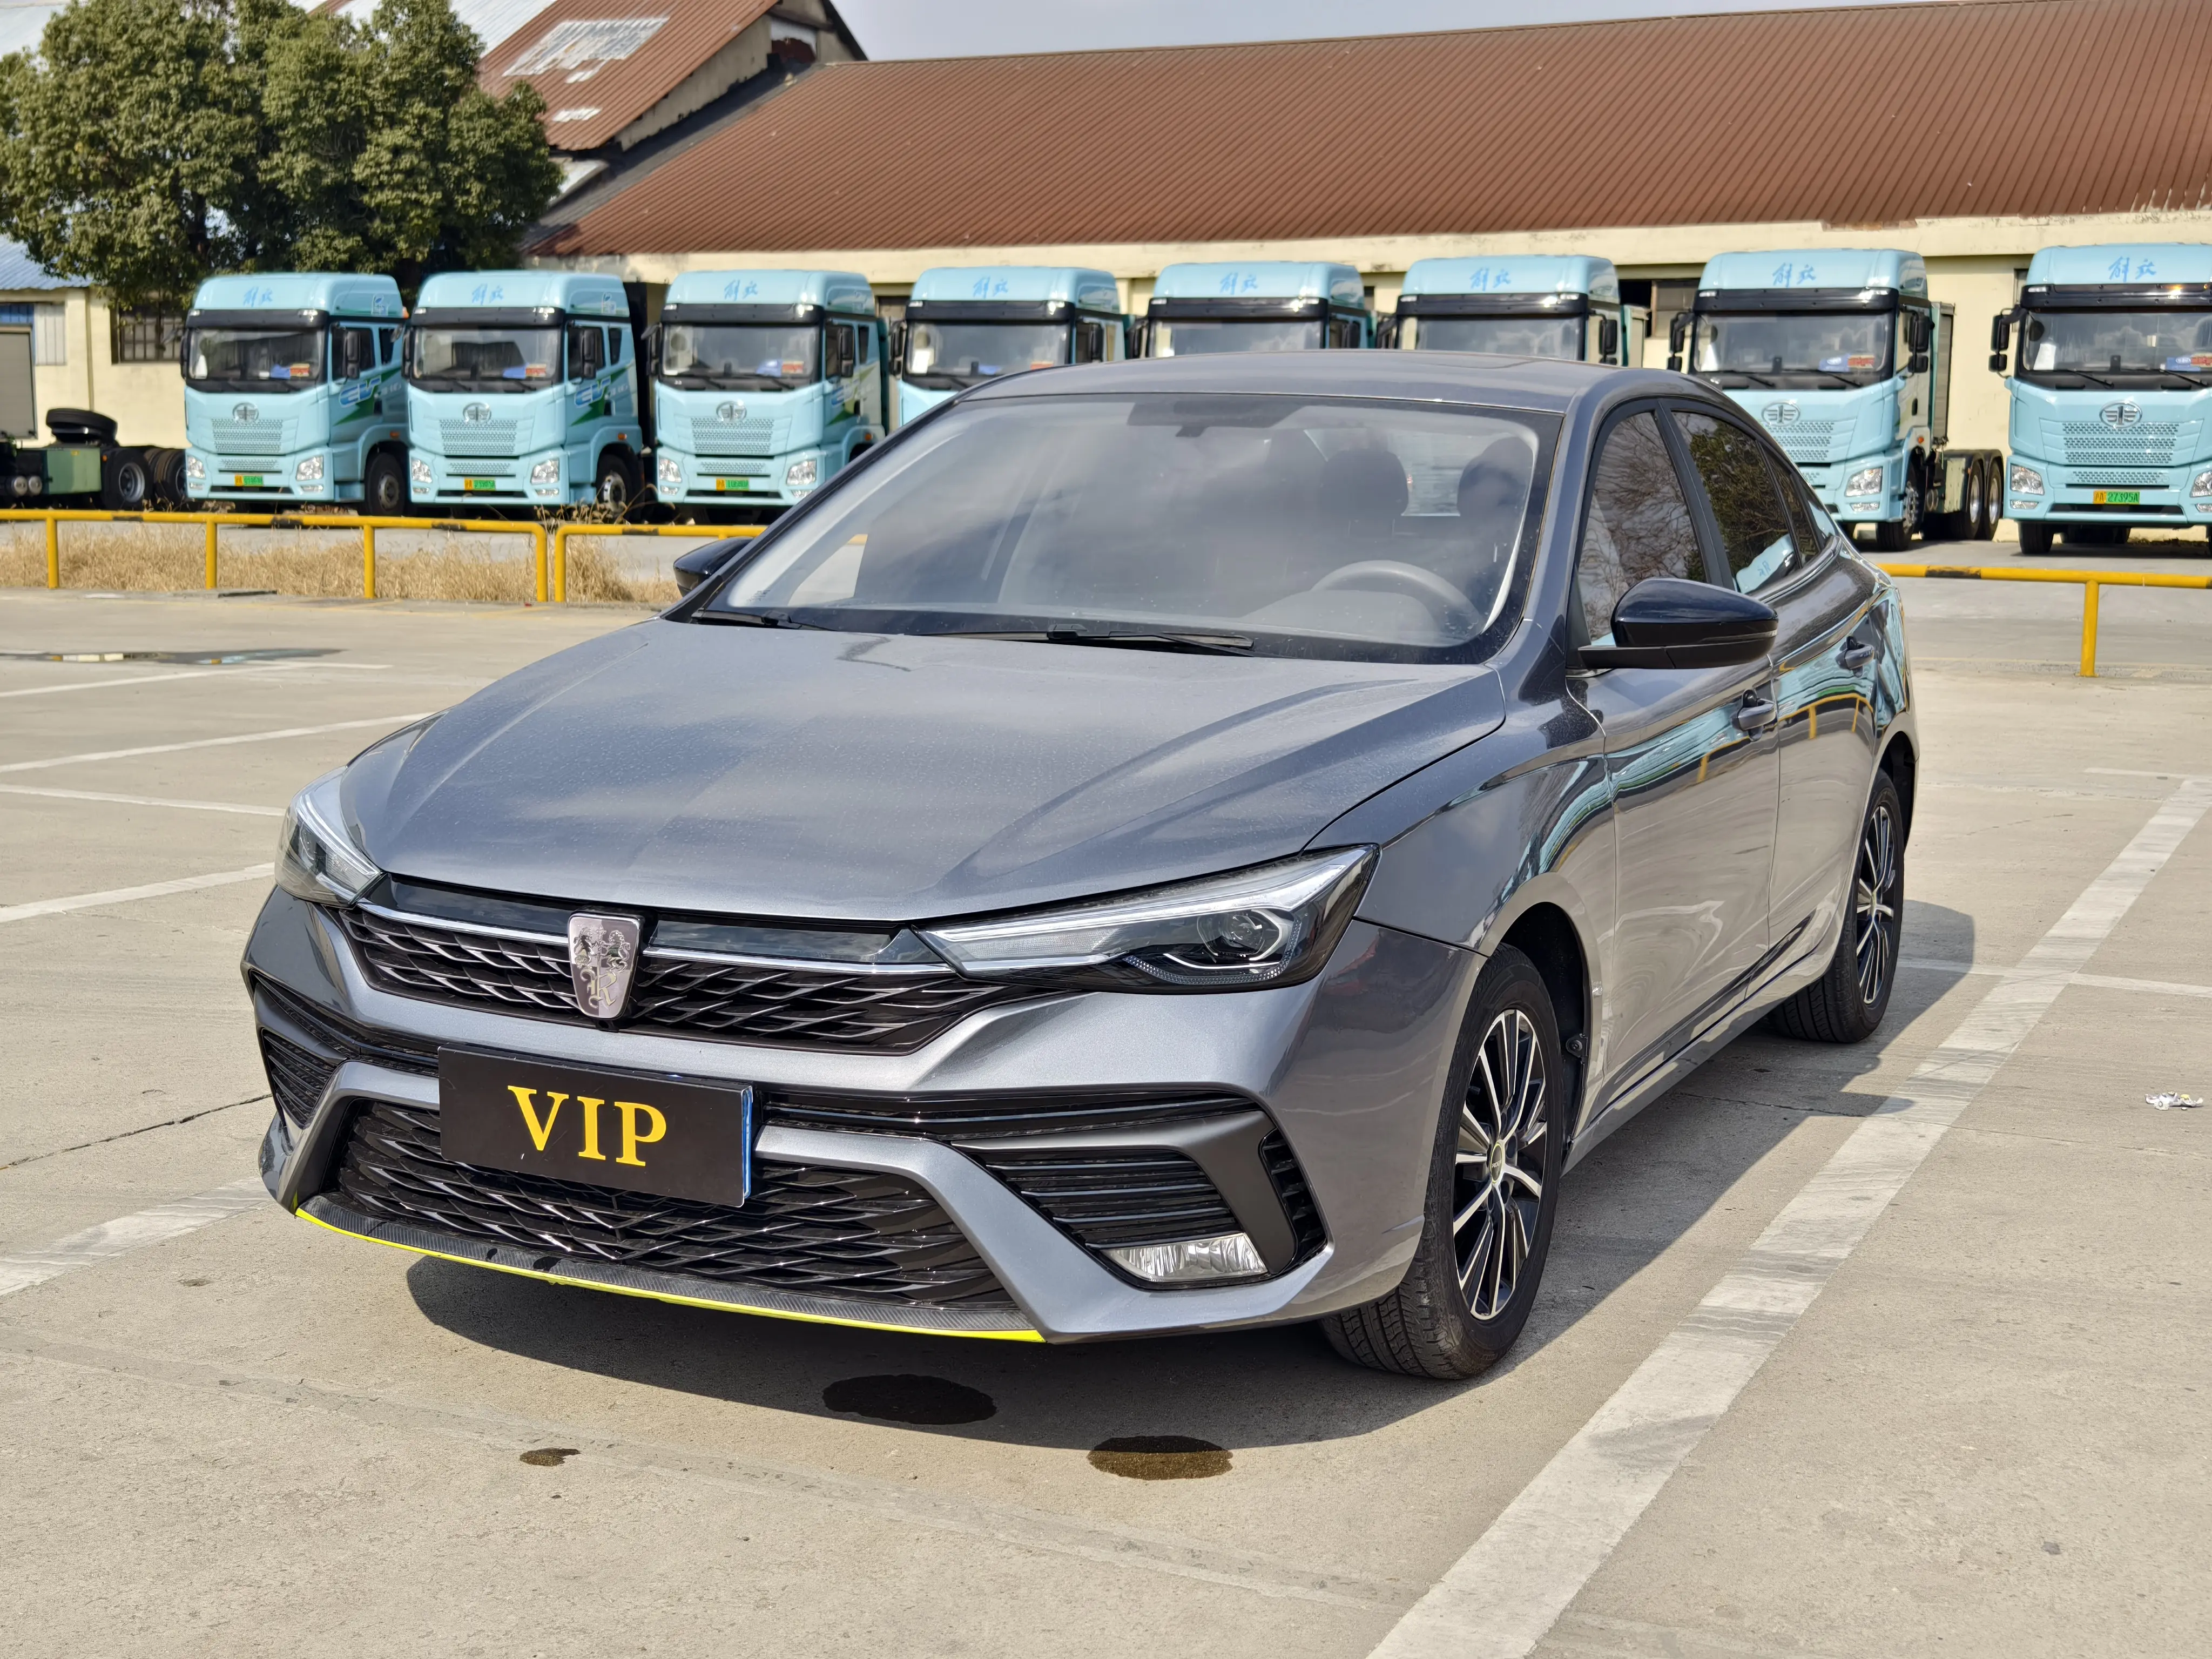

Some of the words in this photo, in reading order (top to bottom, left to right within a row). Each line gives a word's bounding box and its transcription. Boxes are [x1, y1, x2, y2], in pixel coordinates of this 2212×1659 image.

[339, 375, 381, 408] EV
[575, 376, 611, 408] EV
[508, 1085, 667, 1167] VIP
